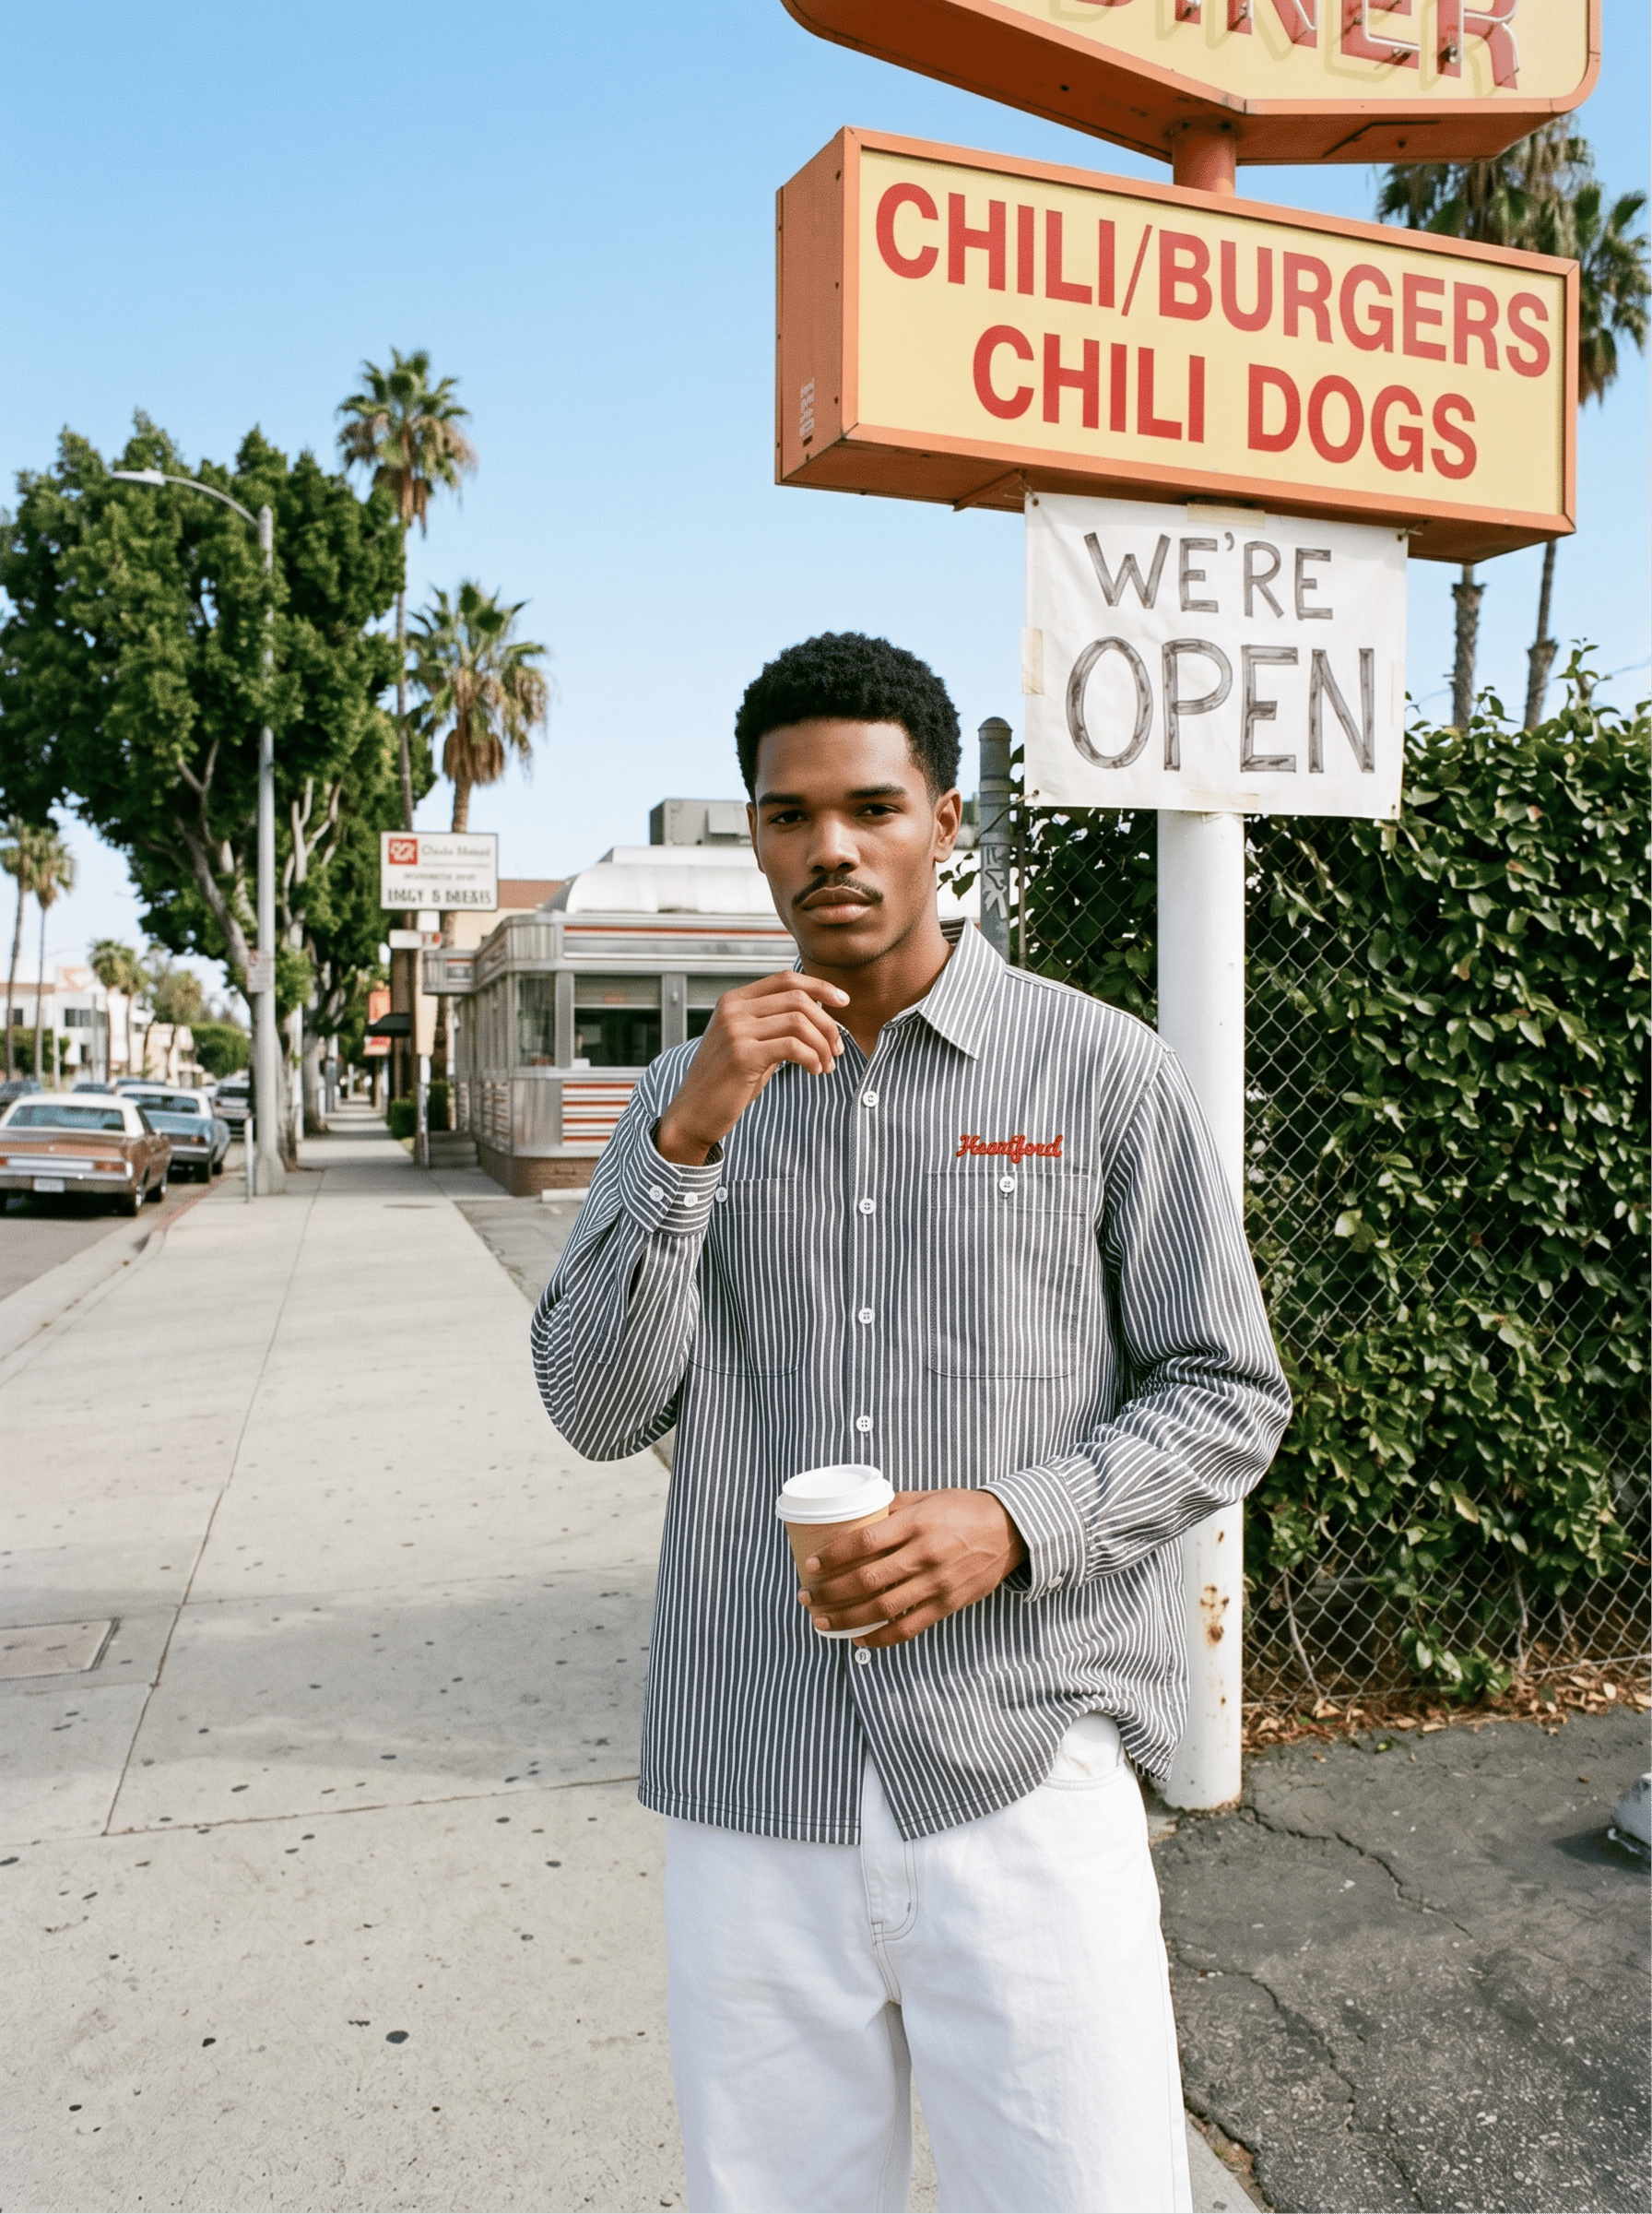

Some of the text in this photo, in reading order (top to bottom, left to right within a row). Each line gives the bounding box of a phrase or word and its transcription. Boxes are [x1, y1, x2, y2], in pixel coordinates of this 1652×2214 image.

[876, 183, 1551, 377] CHILI/BURGERS
[973, 325, 1477, 480] CHILI DOGS
[1083, 531, 1333, 621] WE'RE
[1066, 635, 1375, 775] OPEN
